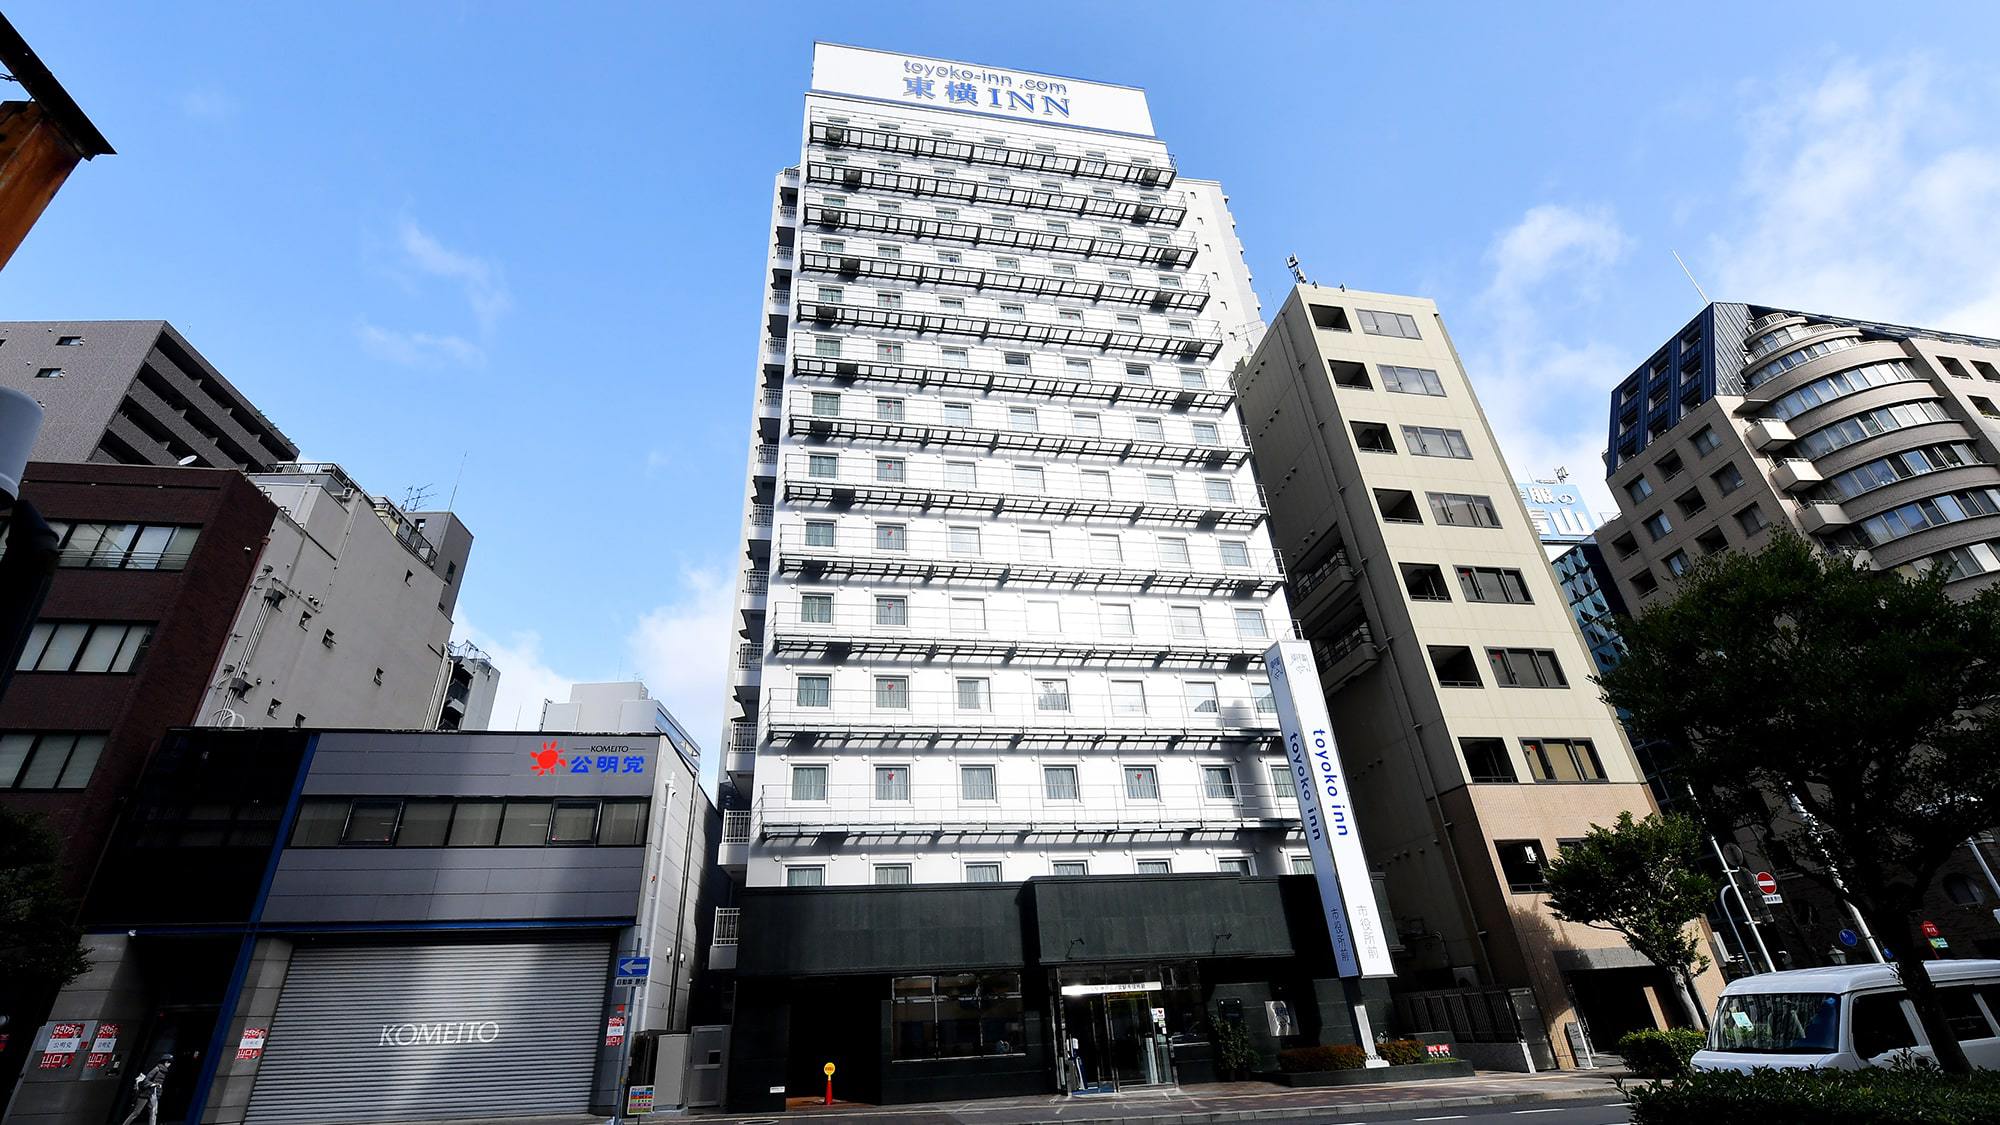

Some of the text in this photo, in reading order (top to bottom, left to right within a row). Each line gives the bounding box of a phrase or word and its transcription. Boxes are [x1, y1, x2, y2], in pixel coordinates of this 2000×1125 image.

[590, 745, 629, 753] KOMEITO
[570, 756, 645, 774] 公明党
[1289, 731, 1322, 842] toyoko inn
[1312, 728, 1349, 837] toyoko inn
[1355, 905, 1379, 960] 市役所前
[378, 1021, 500, 1046] KOMEITO
[41, 1054, 62, 1064] 山口
